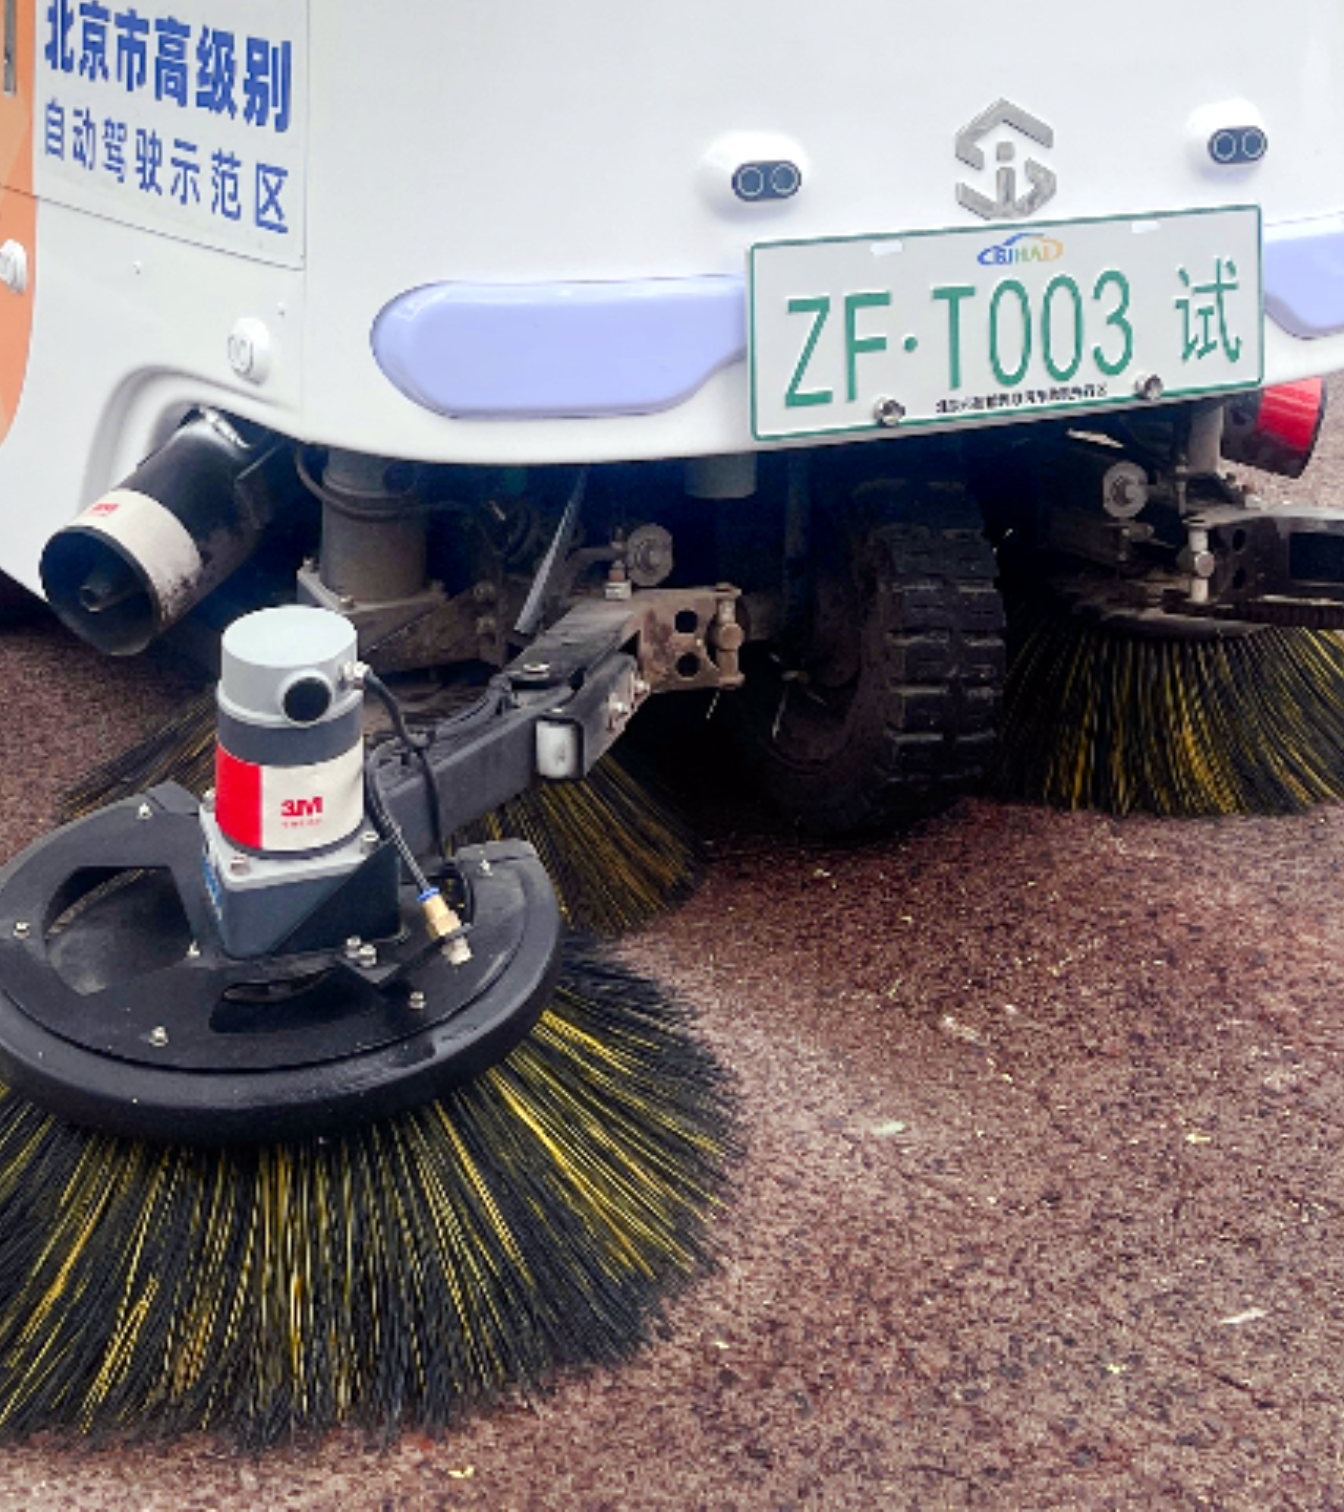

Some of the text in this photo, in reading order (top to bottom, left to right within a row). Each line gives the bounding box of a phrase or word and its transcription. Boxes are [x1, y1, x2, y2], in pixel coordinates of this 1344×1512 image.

[44, 99, 290, 233] 自动驾驶示范区
[785, 257, 1242, 407] ZF·T003 试
[281, 796, 323, 817] 3M
